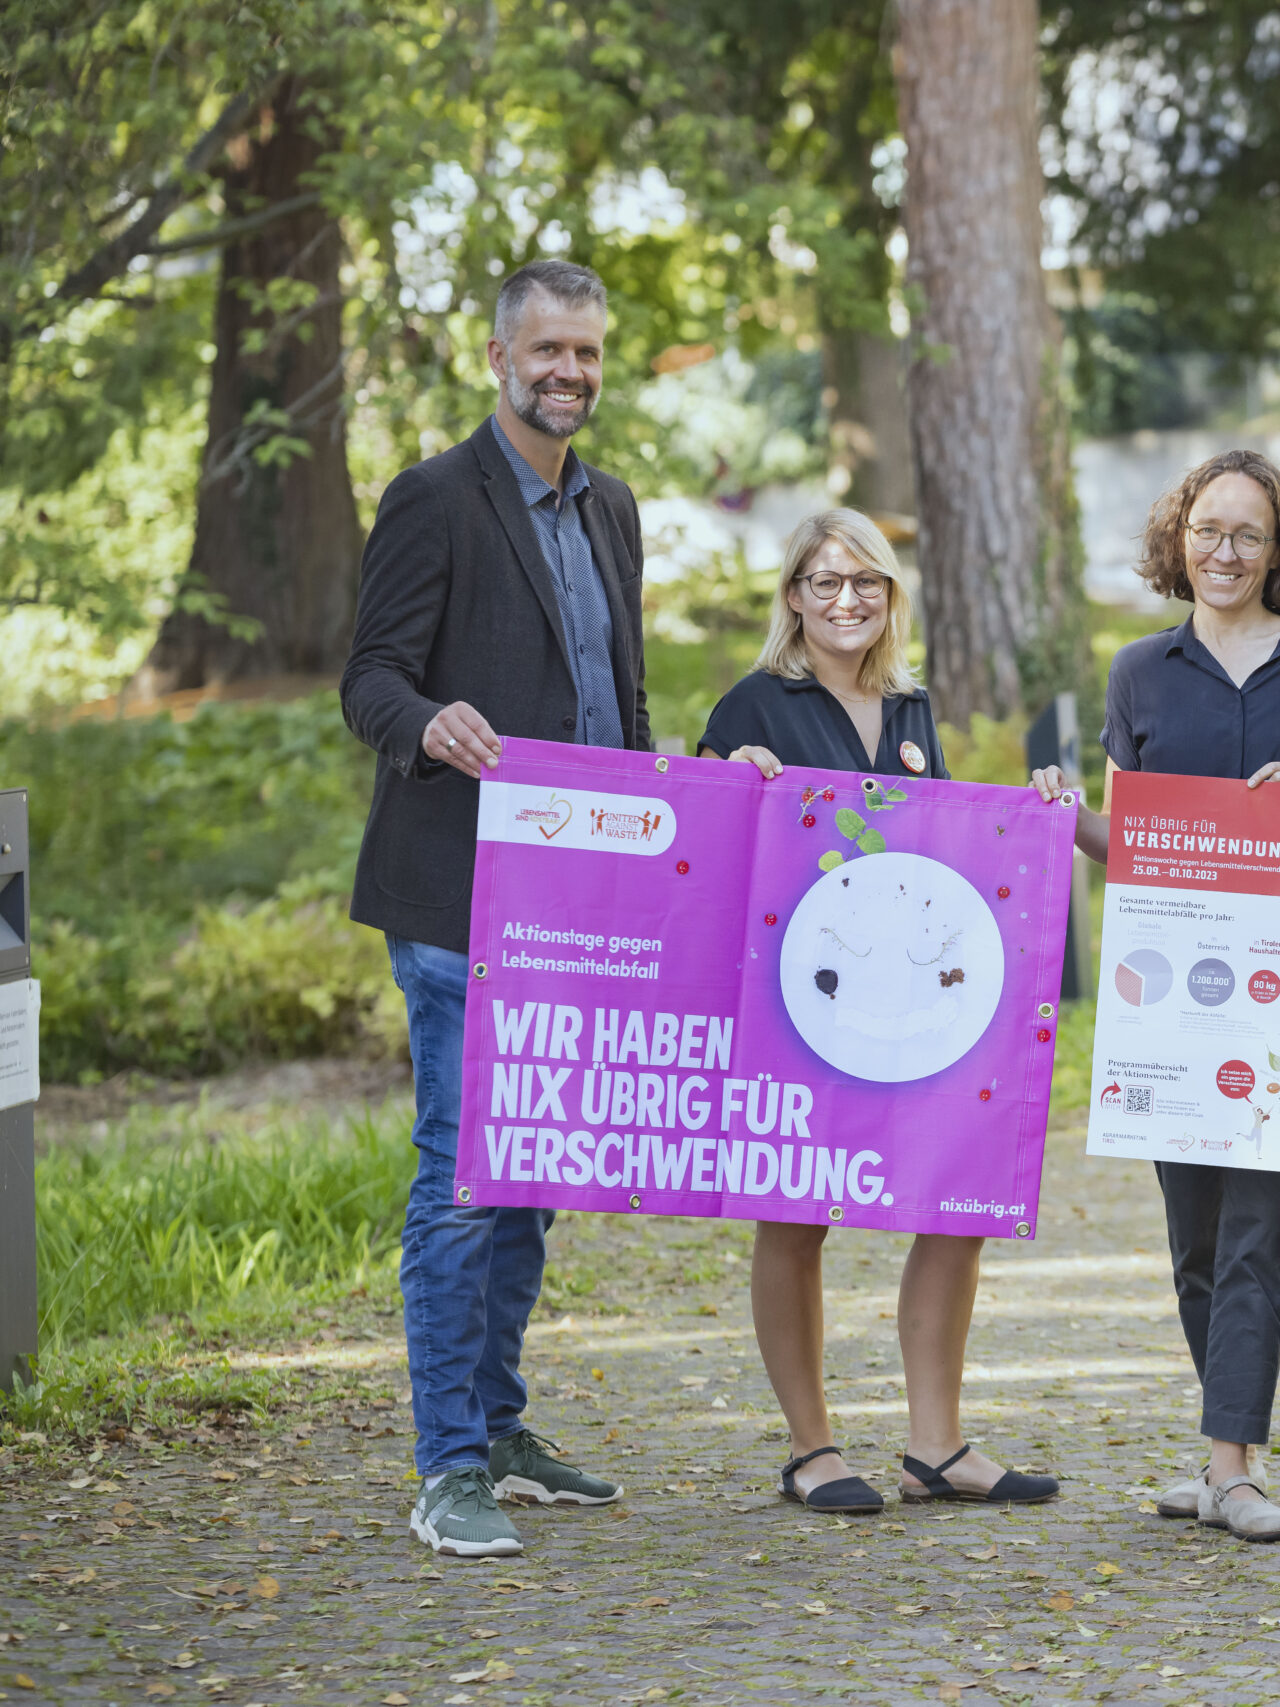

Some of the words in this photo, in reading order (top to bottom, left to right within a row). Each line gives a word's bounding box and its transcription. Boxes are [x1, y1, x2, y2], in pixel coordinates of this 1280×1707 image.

[520, 809, 560, 818] LEBENSMITTEL
[606, 813, 640, 823] UNITED
[605, 821, 638, 831] AGAINST
[1124, 816, 1145, 828] NIX
[1151, 816, 1188, 832] ÜBRIG
[1193, 820, 1216, 834] FÜR
[605, 829, 637, 840] WASTE
[1133, 854, 1178, 866] Aktionswoche
[1179, 859, 1200, 868] gegen
[1119, 896, 1154, 906] Gesamte
[1156, 898, 1206, 910] vermeidbare
[1119, 906, 1198, 919] Lebensmittelabfälle
[1199, 912, 1213, 921] pro
[502, 922, 605, 951] Aktionstage
[608, 936, 662, 955] gegen
[501, 950, 660, 980] Lebensmittelabfall
[1253, 980, 1264, 989] 80
[1265, 981, 1276, 991] kg
[492, 1000, 584, 1060] WIR
[592, 1007, 734, 1070] HABEN
[1107, 1059, 1188, 1073] Programmübersicht
[1107, 1069, 1121, 1077] der
[490, 1062, 573, 1121] NIX
[580, 1062, 711, 1130] ÜBRIG
[720, 1073, 814, 1138] FÜR
[484, 1125, 894, 1206] VERSCHWENDUNG.
[940, 1197, 1026, 1218] nixübrig.at
